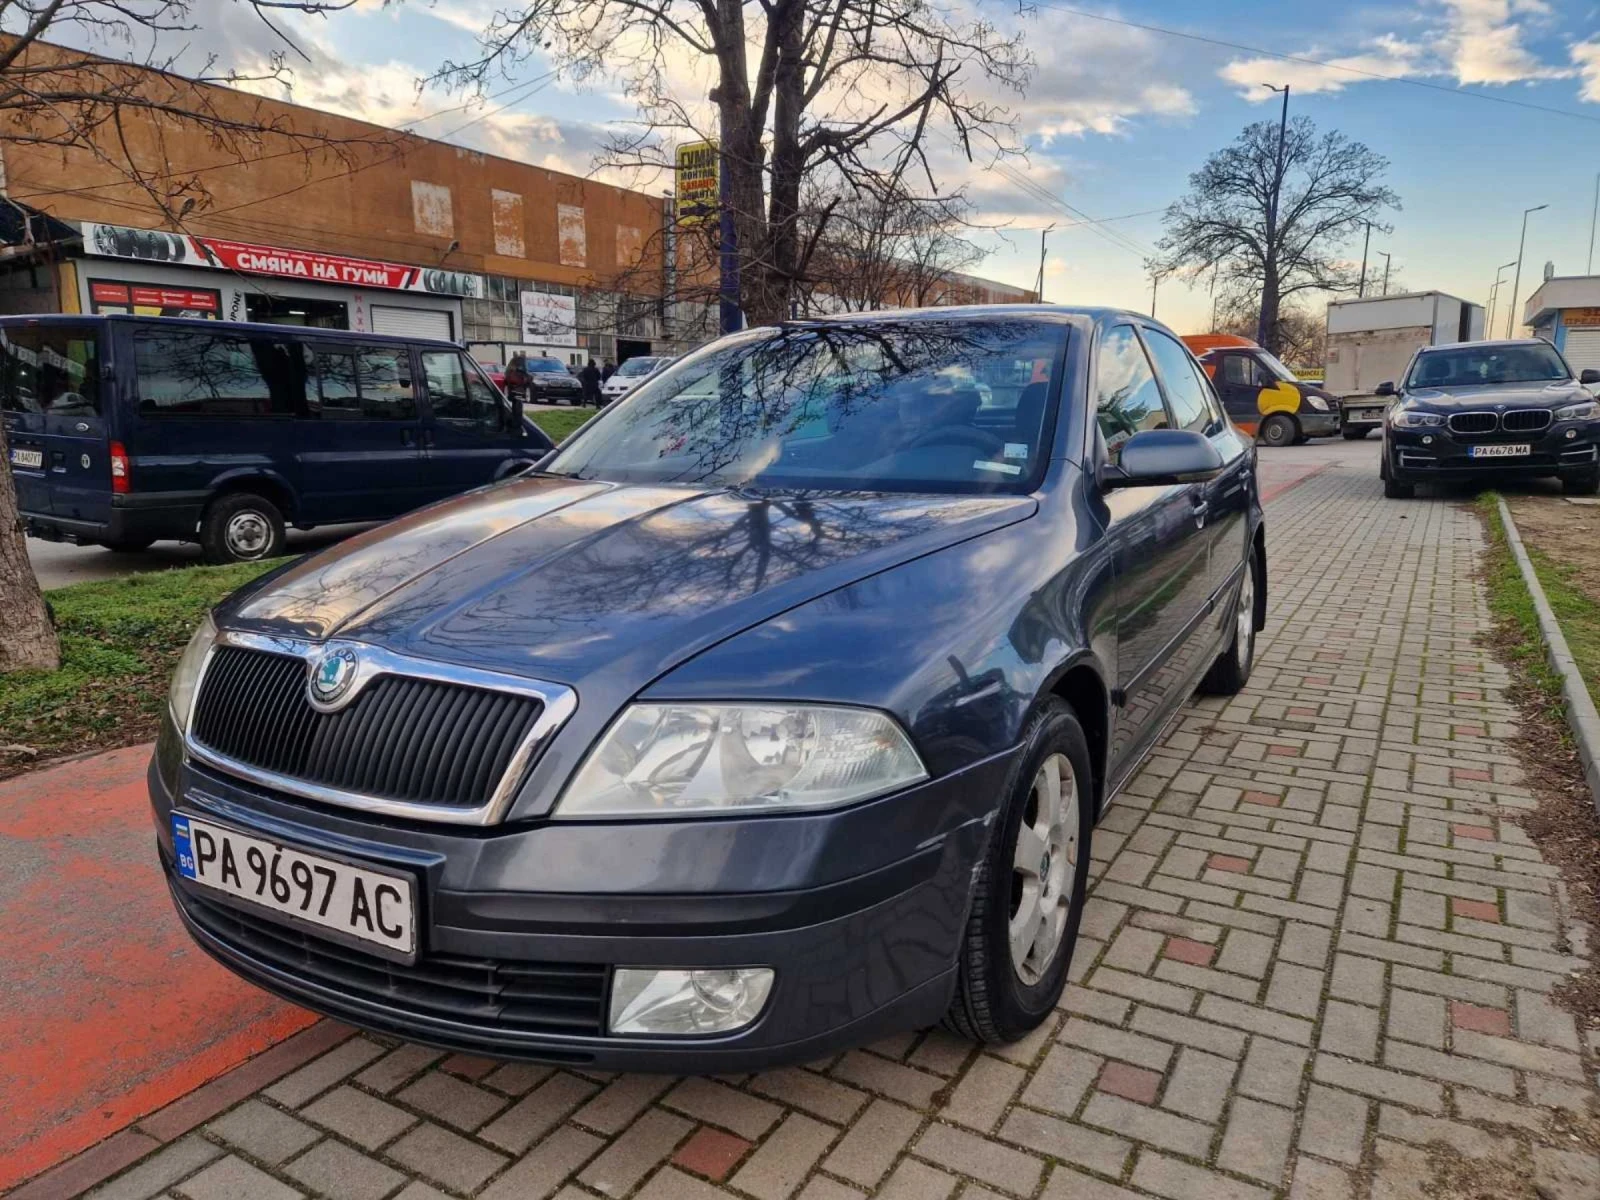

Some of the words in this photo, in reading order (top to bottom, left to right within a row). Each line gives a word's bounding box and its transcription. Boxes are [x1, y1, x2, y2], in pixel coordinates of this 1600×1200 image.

[236, 253, 309, 276] СМЯНА
[312, 261, 339, 280] НА
[342, 266, 389, 285] ГУМИ
[1475, 447, 1488, 456] PA
[1489, 446, 1514, 456] 6678
[1515, 445, 1528, 455] MA
[179, 853, 195, 871] BG
[193, 828, 242, 889] PA
[246, 846, 337, 917] 9697
[350, 876, 404, 940] AC
